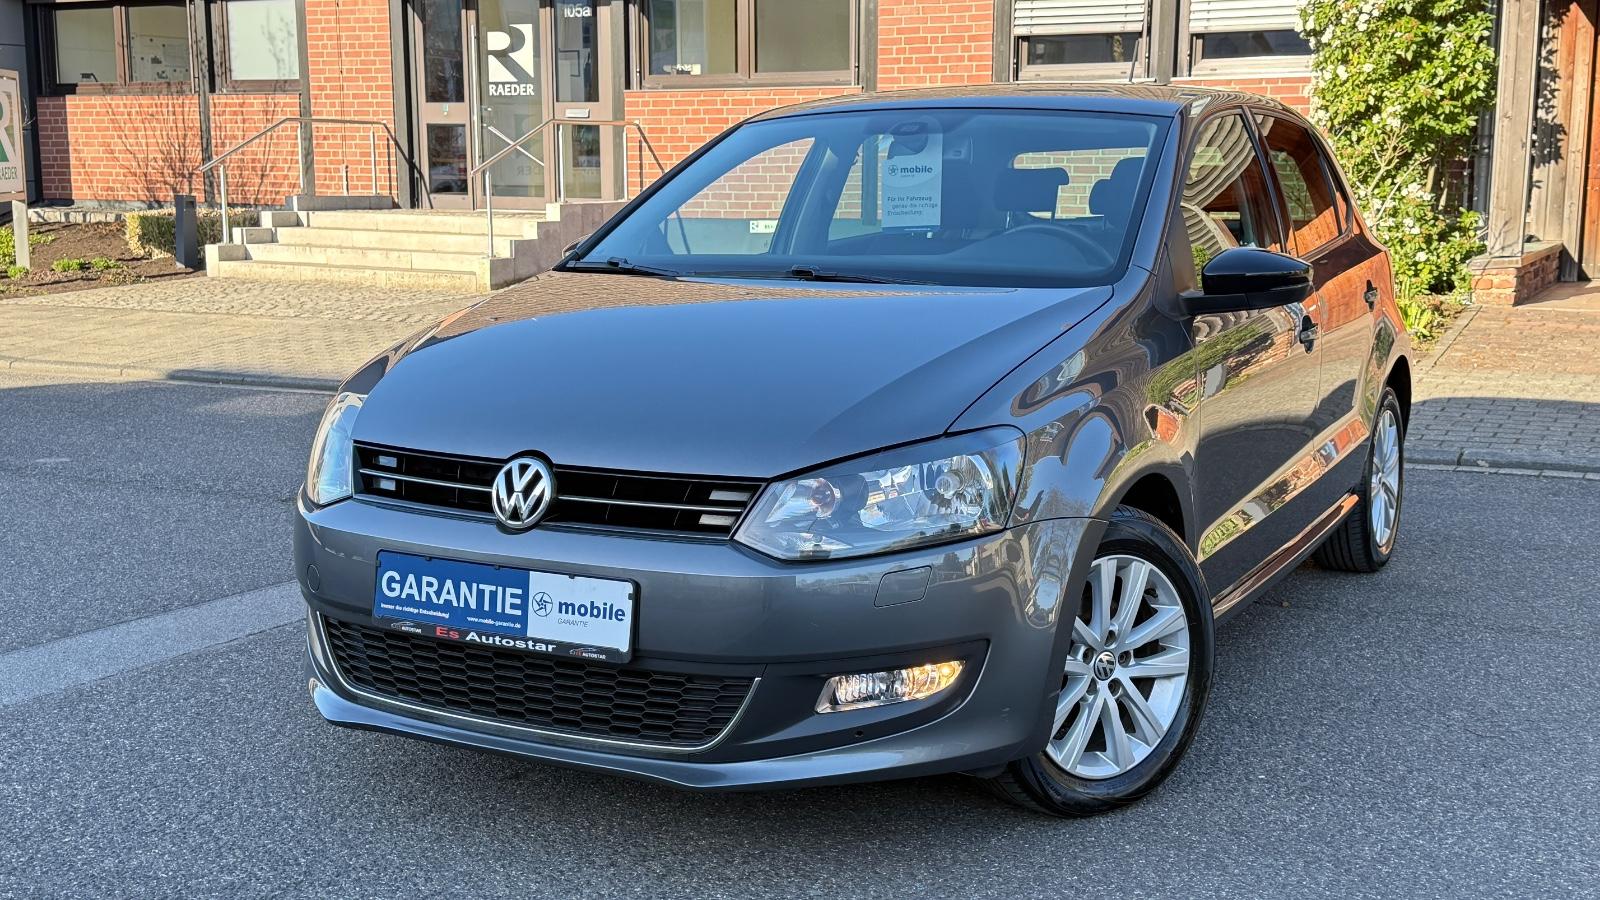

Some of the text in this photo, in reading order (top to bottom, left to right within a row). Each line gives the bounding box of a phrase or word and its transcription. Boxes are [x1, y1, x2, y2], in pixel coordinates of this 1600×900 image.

[564, 5, 592, 17] 105a
[489, 84, 534, 96] RAEDER
[900, 165, 934, 173] mobile
[381, 570, 523, 616] GARANTIE
[558, 600, 626, 622] mobile
[558, 617, 589, 628] GARANTIE
[435, 626, 460, 639] Es
[465, 631, 557, 652] Autostar
